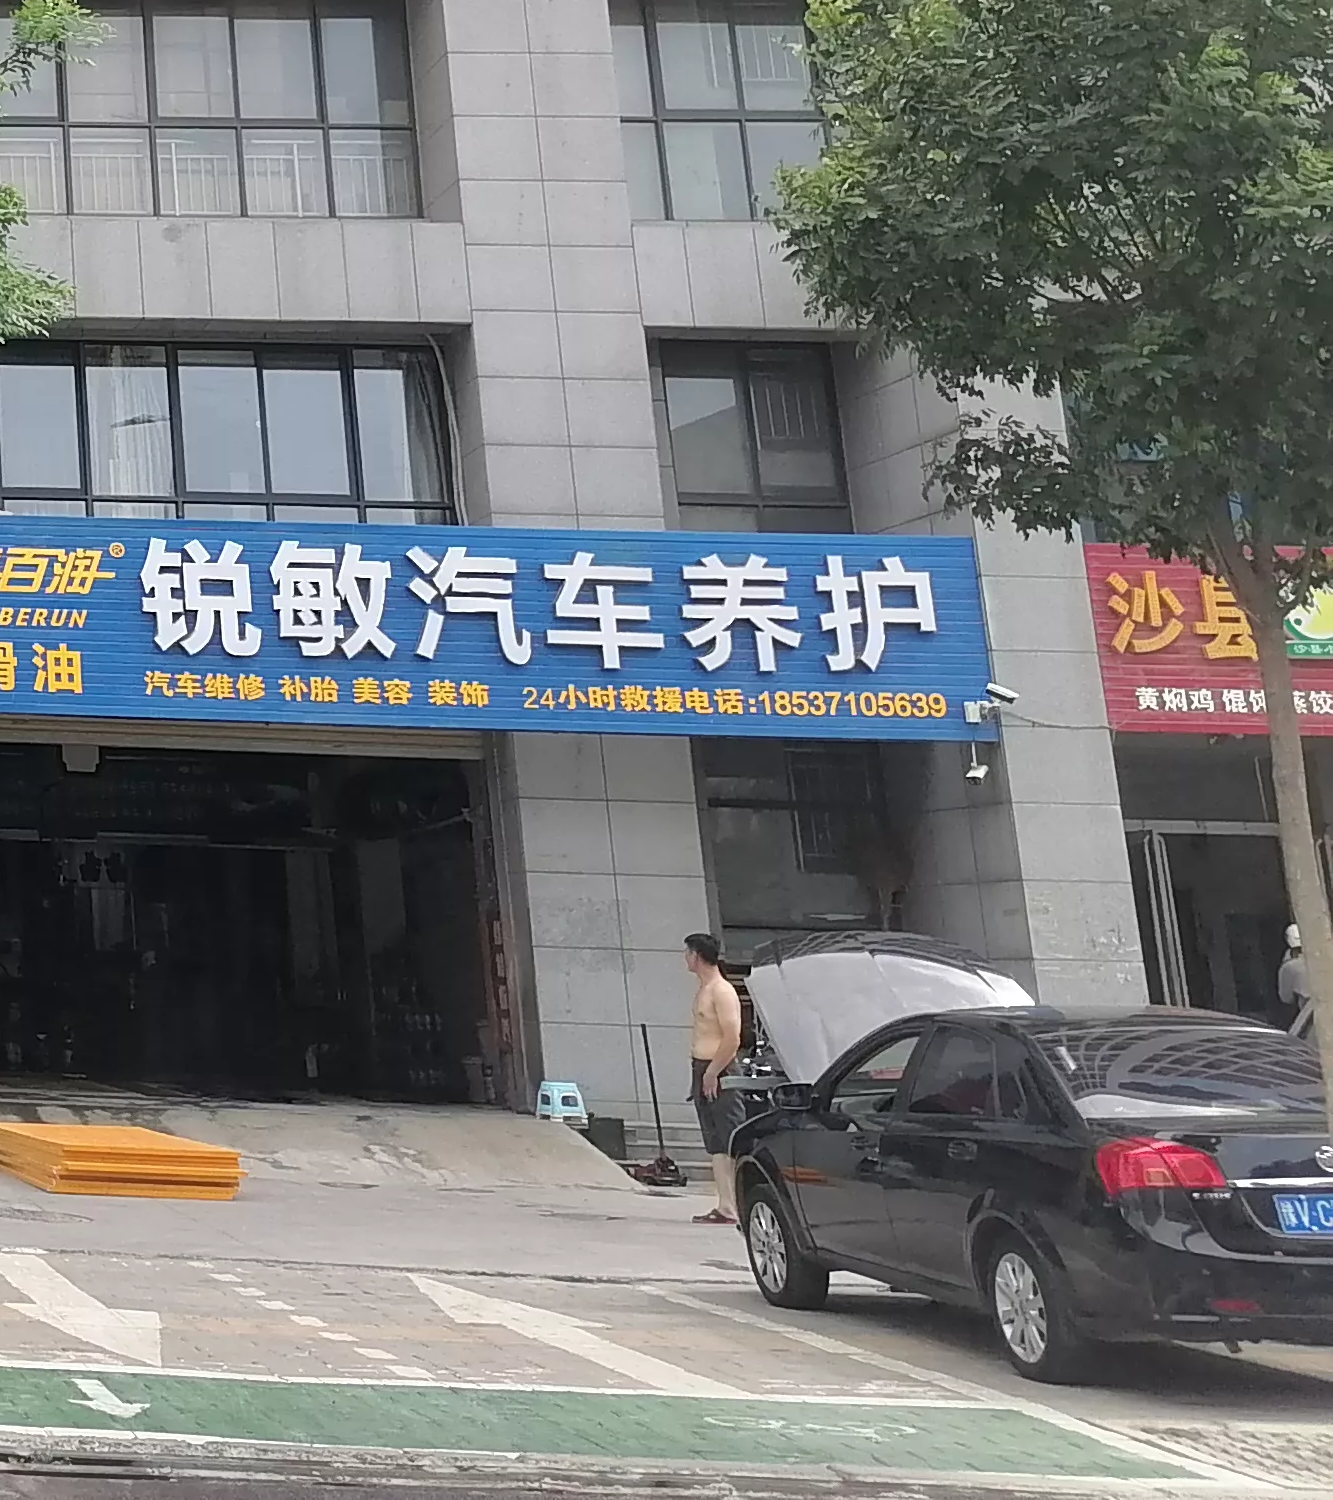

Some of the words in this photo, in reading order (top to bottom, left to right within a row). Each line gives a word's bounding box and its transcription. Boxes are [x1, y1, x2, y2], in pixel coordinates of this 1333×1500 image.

[139, 536, 938, 674] 锐敏汽车养护
[144, 670, 266, 700] 汽车维修
[279, 674, 339, 703] 补胎
[352, 678, 412, 705] 美容
[427, 680, 490, 708] 装饰
[1135, 686, 1215, 713] 黄焖鸡
